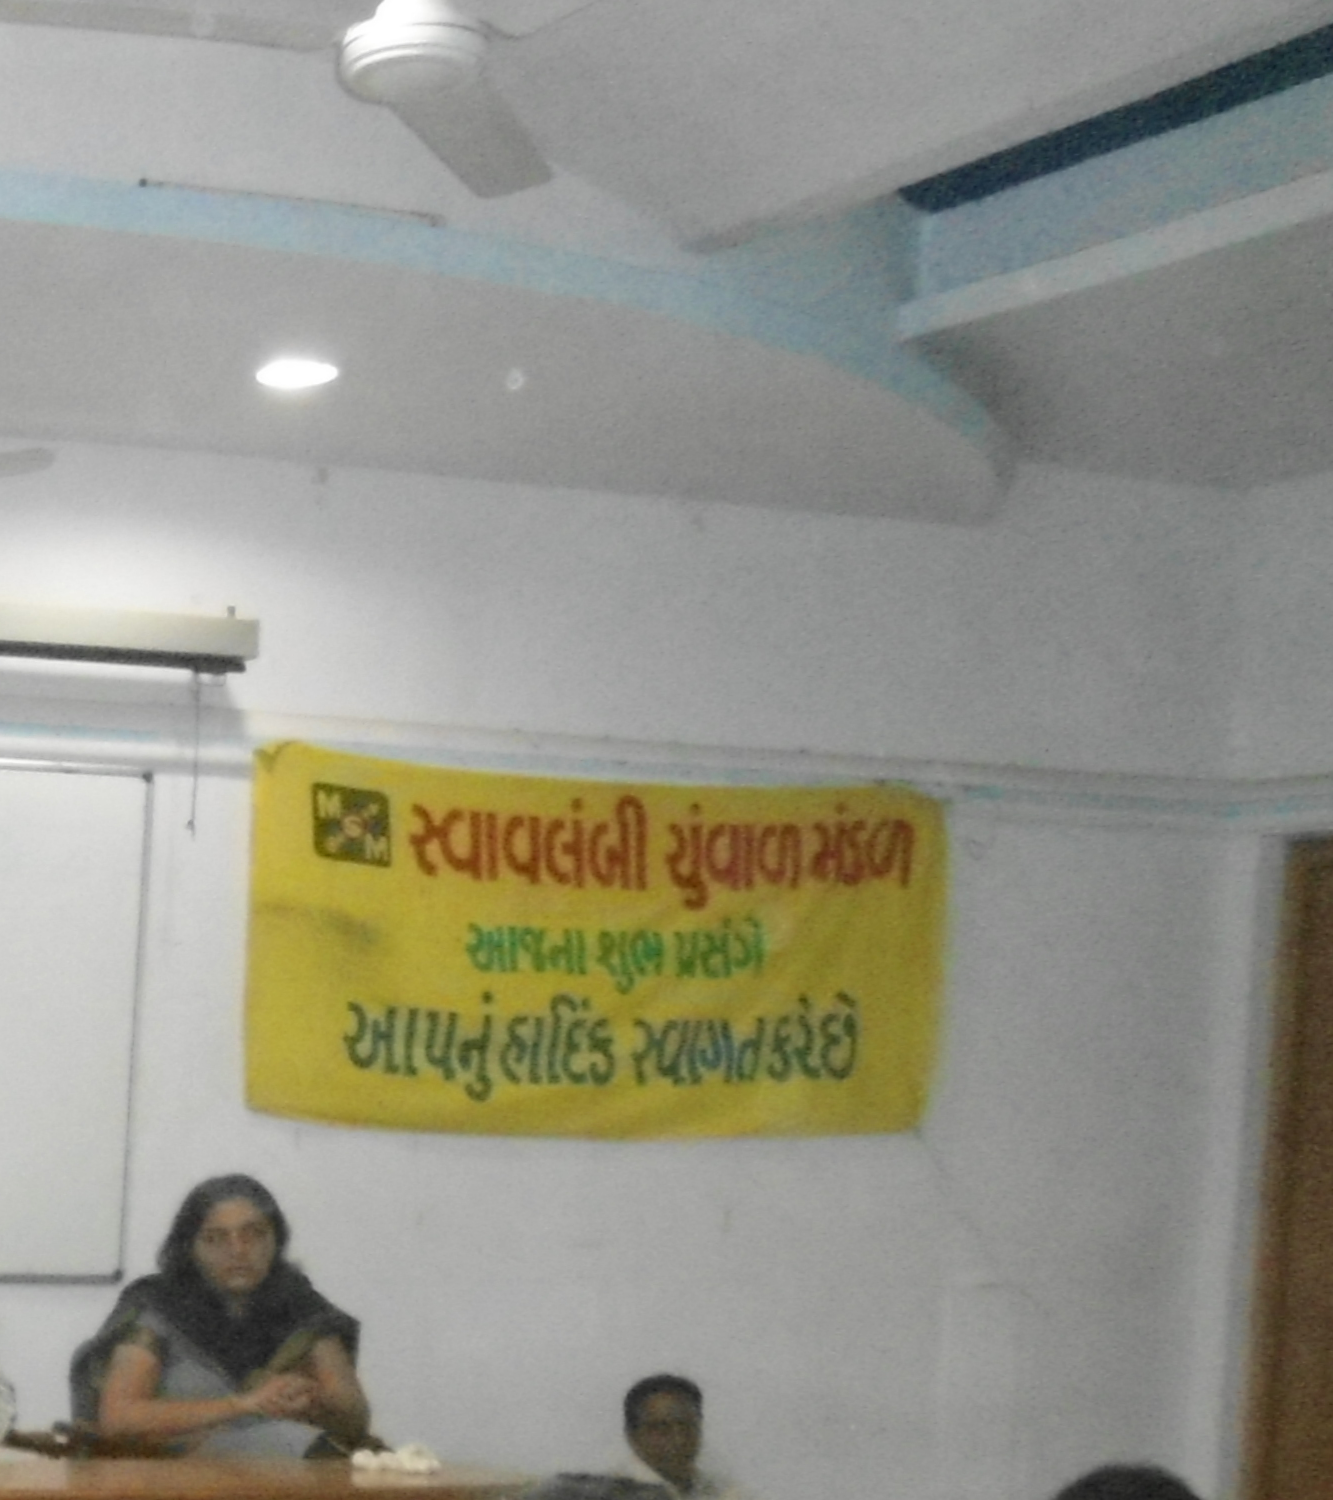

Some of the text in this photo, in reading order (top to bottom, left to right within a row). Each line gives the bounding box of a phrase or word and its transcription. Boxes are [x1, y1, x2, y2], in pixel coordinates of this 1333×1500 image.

[409, 795, 647, 891] સ્વાવલંબી
[465, 922, 586, 976] આજના
[343, 991, 493, 1102] આપનું
